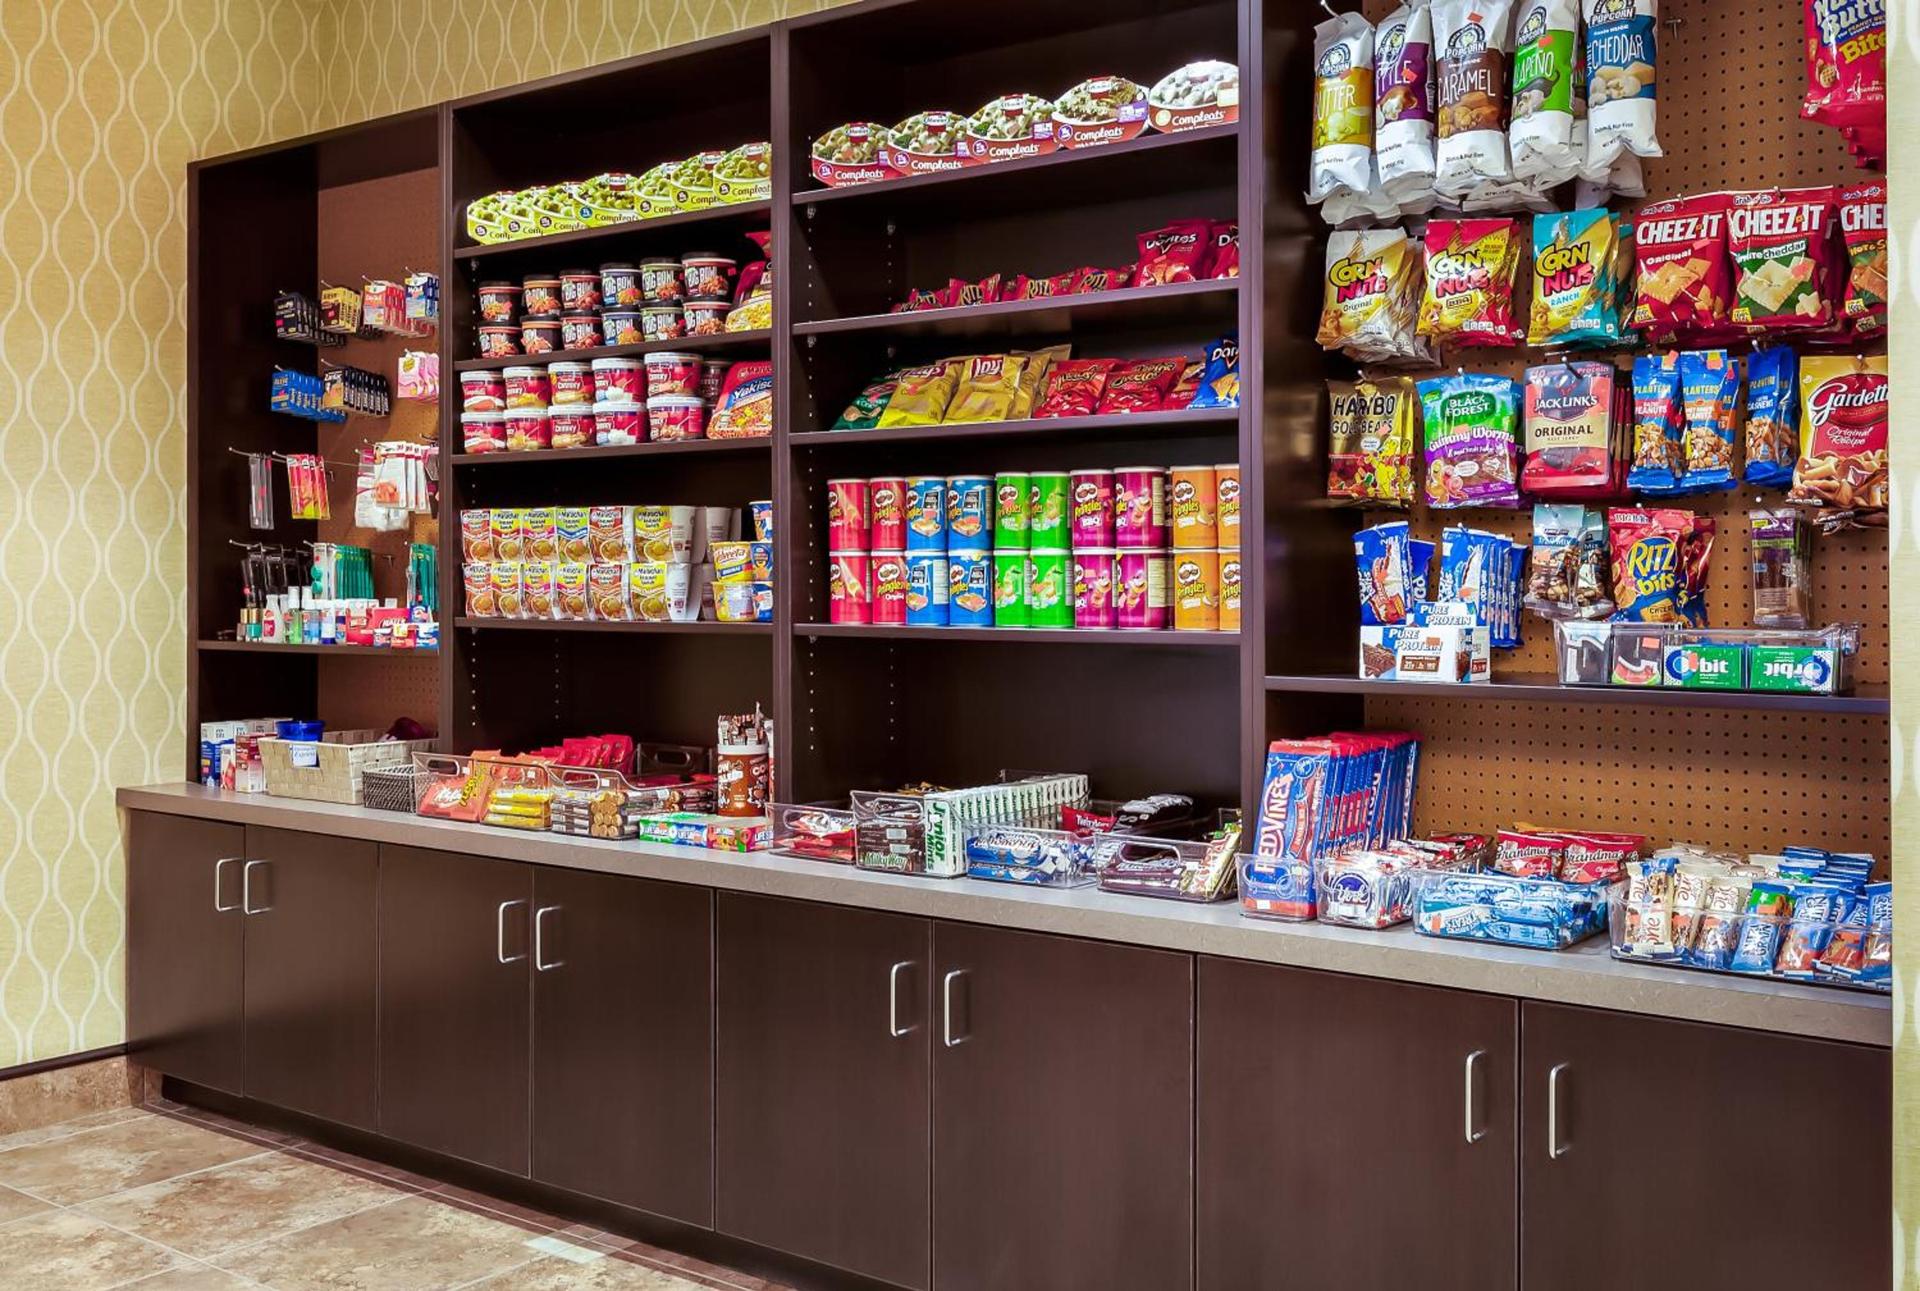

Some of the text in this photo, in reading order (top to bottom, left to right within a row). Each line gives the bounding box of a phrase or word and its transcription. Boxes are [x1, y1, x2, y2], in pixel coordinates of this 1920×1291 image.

[1821, 0, 1887, 44] Butt
[1591, 34, 1646, 70] CHEDDAR
[1839, 31, 1887, 64] Bite
[1315, 84, 1356, 121] UTTER
[1172, 110, 1225, 127] Compleats
[1074, 127, 1124, 144] Compleats
[989, 144, 1040, 158] Compleats
[911, 160, 963, 172] Compleats
[835, 169, 885, 182] Compleats
[1646, 249, 1692, 265] ORIGINAL
[1763, 240, 1807, 259] cheddar
[1428, 249, 1484, 278] CORN
[1535, 241, 1590, 277] CORN
[1328, 256, 1385, 288] CORN
[1542, 263, 1595, 297] NUTS
[616, 275, 635, 289] BOWL
[1336, 276, 1388, 304] NUTS
[1436, 270, 1490, 299] NUTS
[1550, 291, 1580, 306] RANCH
[733, 378, 772, 401] Yakiso
[1682, 385, 1721, 395] PLANTERS
[1333, 395, 1396, 416] HARIBO
[1449, 394, 1485, 408] BLACK
[1535, 398, 1562, 411] JACK
[1446, 403, 1490, 417] FOREST
[1429, 431, 1471, 452] Gummy
[1472, 426, 1515, 443] Worms
[1535, 425, 1594, 438] ORIGINAL
[1826, 426, 1872, 439] Original
[1831, 434, 1866, 447] Recipe
[1074, 501, 1102, 519] Pringles
[1628, 542, 1676, 577] RITZ
[1637, 573, 1676, 595] bits
[1420, 604, 1450, 615] PURE
[1425, 615, 1472, 626] PROTEIN
[1388, 628, 1421, 640] PURE
[933, 802, 946, 862] Jnior
